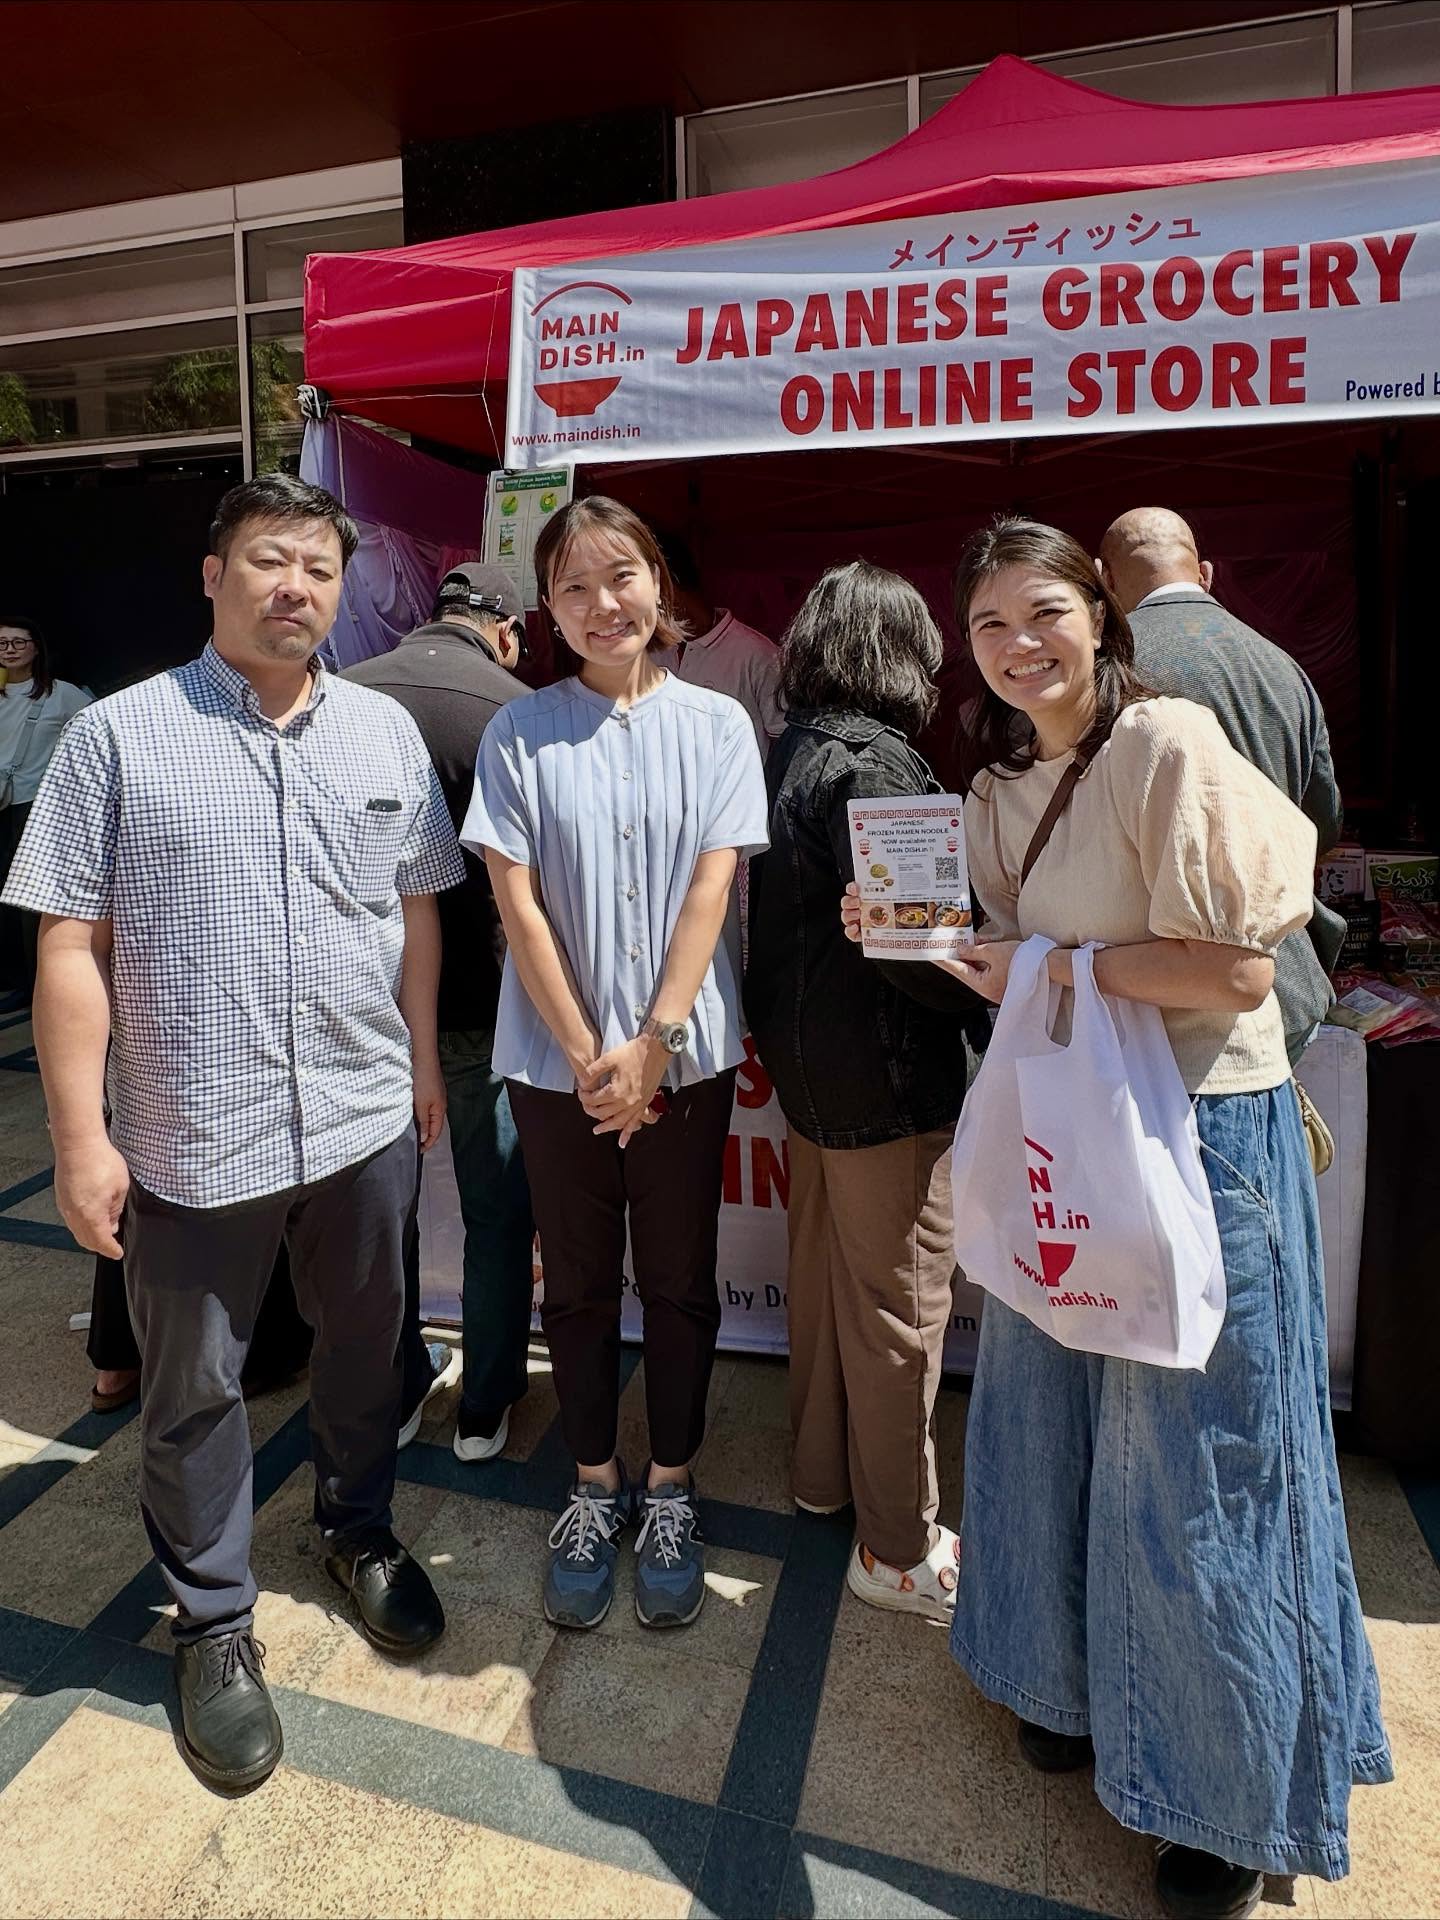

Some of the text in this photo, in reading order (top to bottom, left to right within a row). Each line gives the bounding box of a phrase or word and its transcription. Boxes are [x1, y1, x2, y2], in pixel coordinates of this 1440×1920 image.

[888, 212, 1201, 270] メインディッシュ
[676, 232, 1417, 365] JAPANESE GROCERY
[541, 311, 619, 341] MAIN
[540, 341, 645, 370] DISH.in
[780, 336, 1307, 436] ONLINE STORE
[1346, 371, 1440, 401] Powered b
[512, 424, 641, 447] www.maindish.in
[890, 819, 925, 827] JAPANESE
[1032, 1200, 1090, 1229] H.in
[725, 1280, 754, 1311] by
